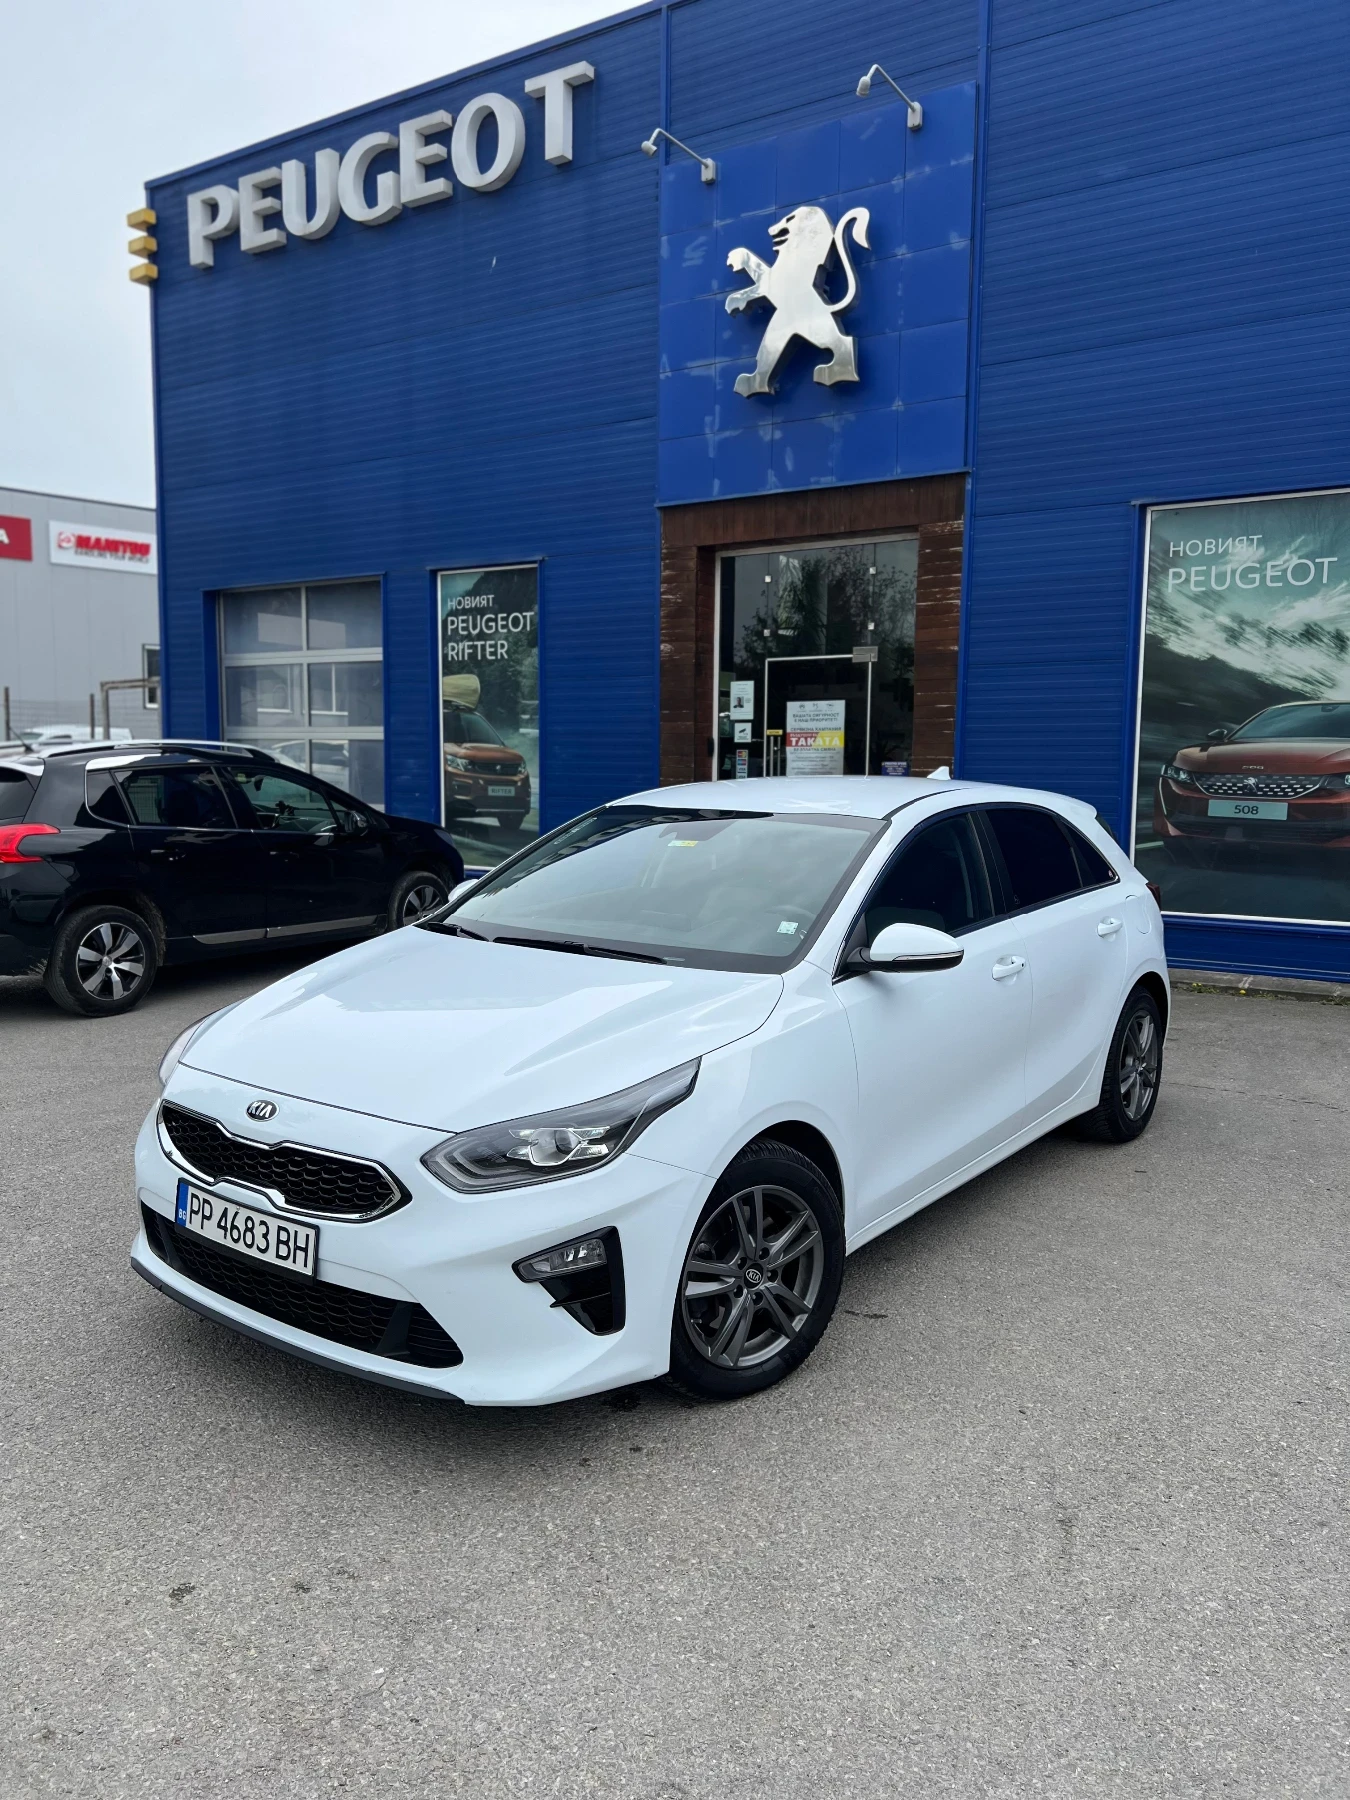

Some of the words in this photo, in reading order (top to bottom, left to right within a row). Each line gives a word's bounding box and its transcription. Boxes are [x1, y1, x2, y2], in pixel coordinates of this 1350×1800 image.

[187, 60, 595, 269] PEUGEOT
[1169, 534, 1263, 558] НОВИЯТ
[1167, 557, 1338, 593] PEUGEOT
[447, 594, 495, 611] НОВИЯТ
[447, 611, 535, 636] PEUGEOT
[447, 640, 509, 662] RIFTER
[491, 787, 512, 795] RIFTER
[1233, 803, 1259, 816] 508
[247, 1101, 273, 1119] KIA
[189, 1192, 214, 1230] PP
[216, 1206, 270, 1255] 4683
[275, 1224, 311, 1269] BH
[747, 1270, 761, 1283] KIA
